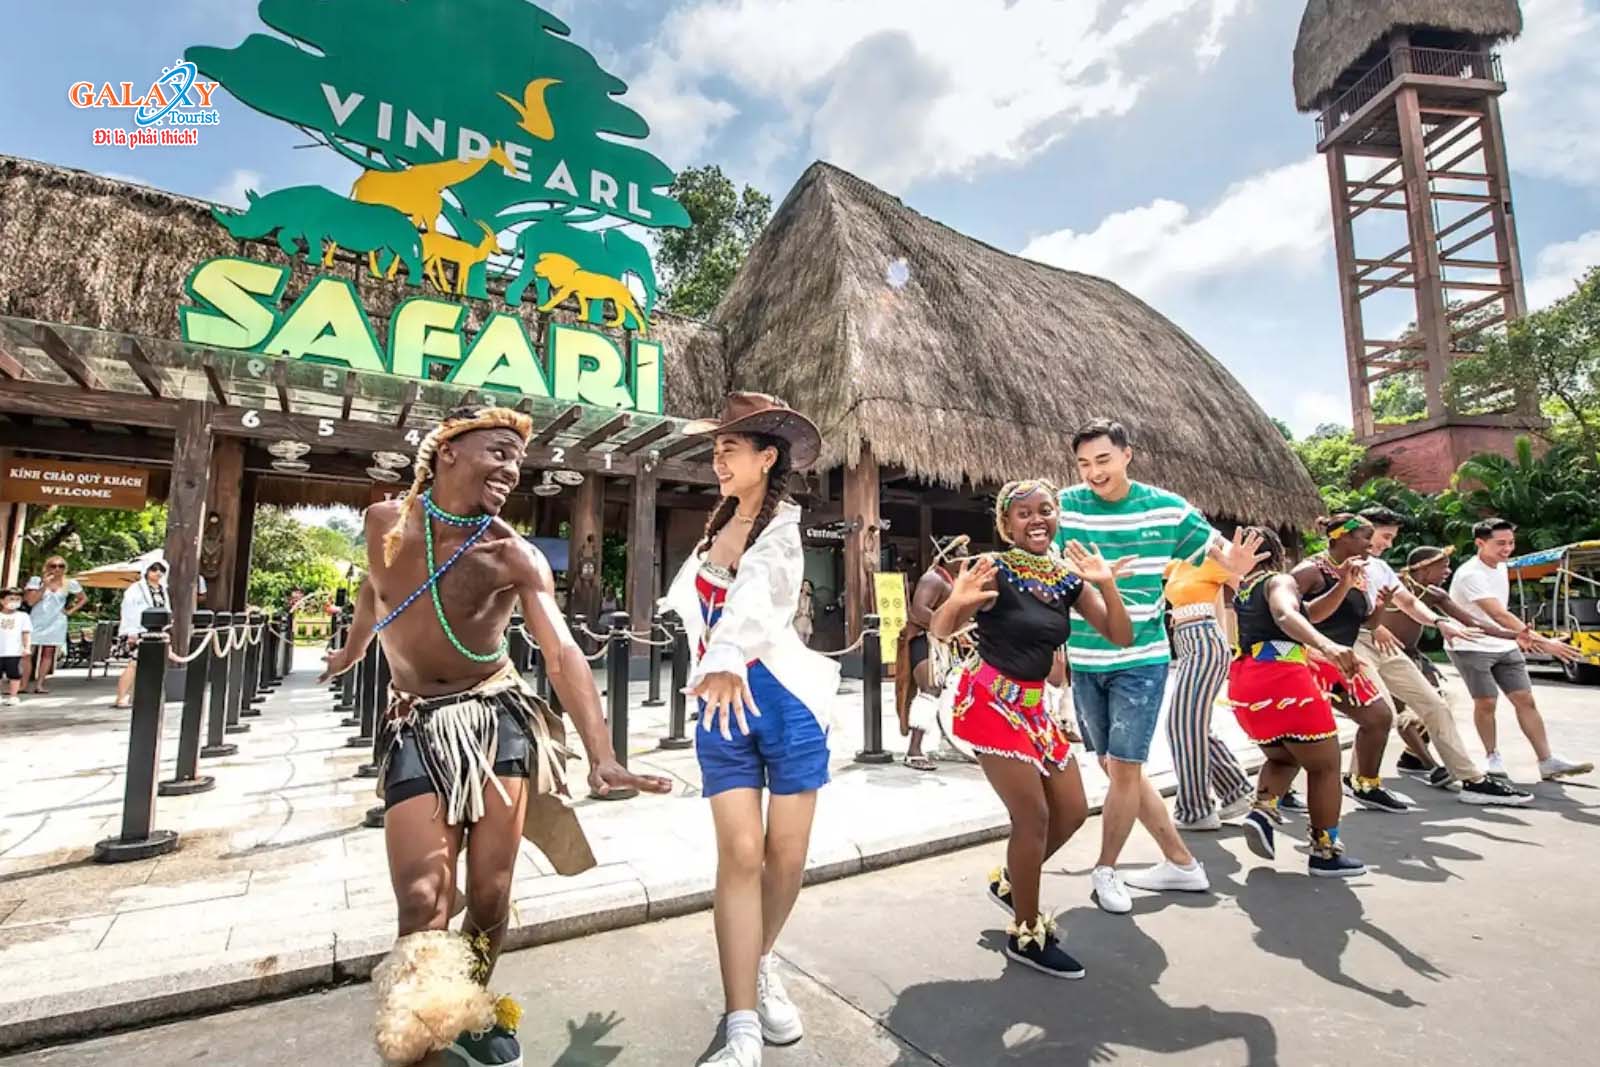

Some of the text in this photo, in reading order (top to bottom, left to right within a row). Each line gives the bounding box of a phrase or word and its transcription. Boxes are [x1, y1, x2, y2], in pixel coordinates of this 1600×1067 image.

[320, 82, 652, 219] VINPEARL
[180, 257, 662, 414] SAFARI
[241, 410, 612, 469] 6 5 4 2 1
[10, 467, 41, 480] KÍNH
[43, 470, 75, 482] CHÀO
[103, 475, 142, 487] KHÁCH
[41, 485, 112, 498] WELCOME
